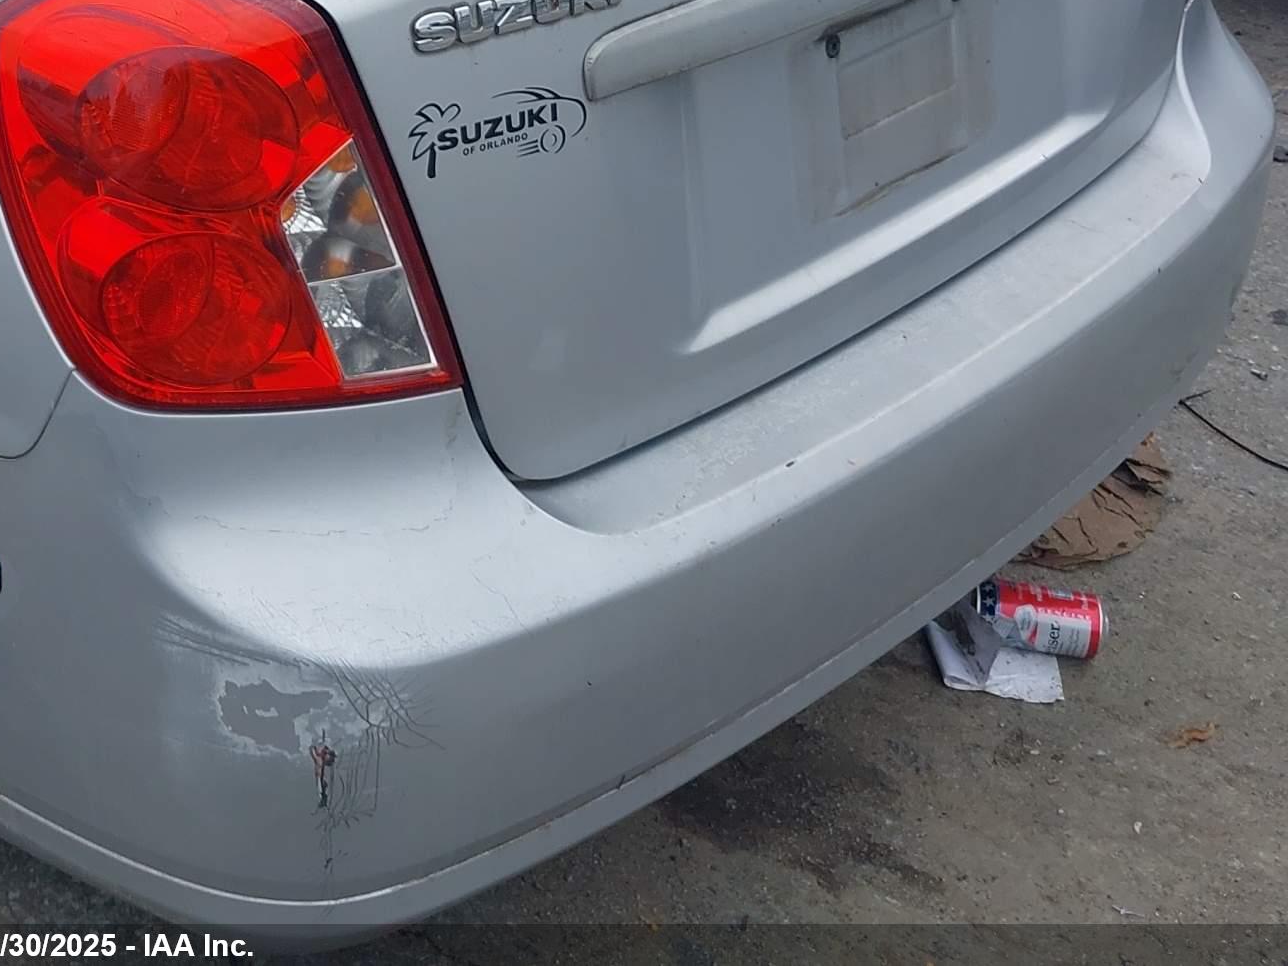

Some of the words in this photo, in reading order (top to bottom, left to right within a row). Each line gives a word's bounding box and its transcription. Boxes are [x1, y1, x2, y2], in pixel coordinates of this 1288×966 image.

[437, 102, 558, 151] SUZUKI
[462, 146, 475, 156] OF
[479, 132, 528, 152] ORLANDO
